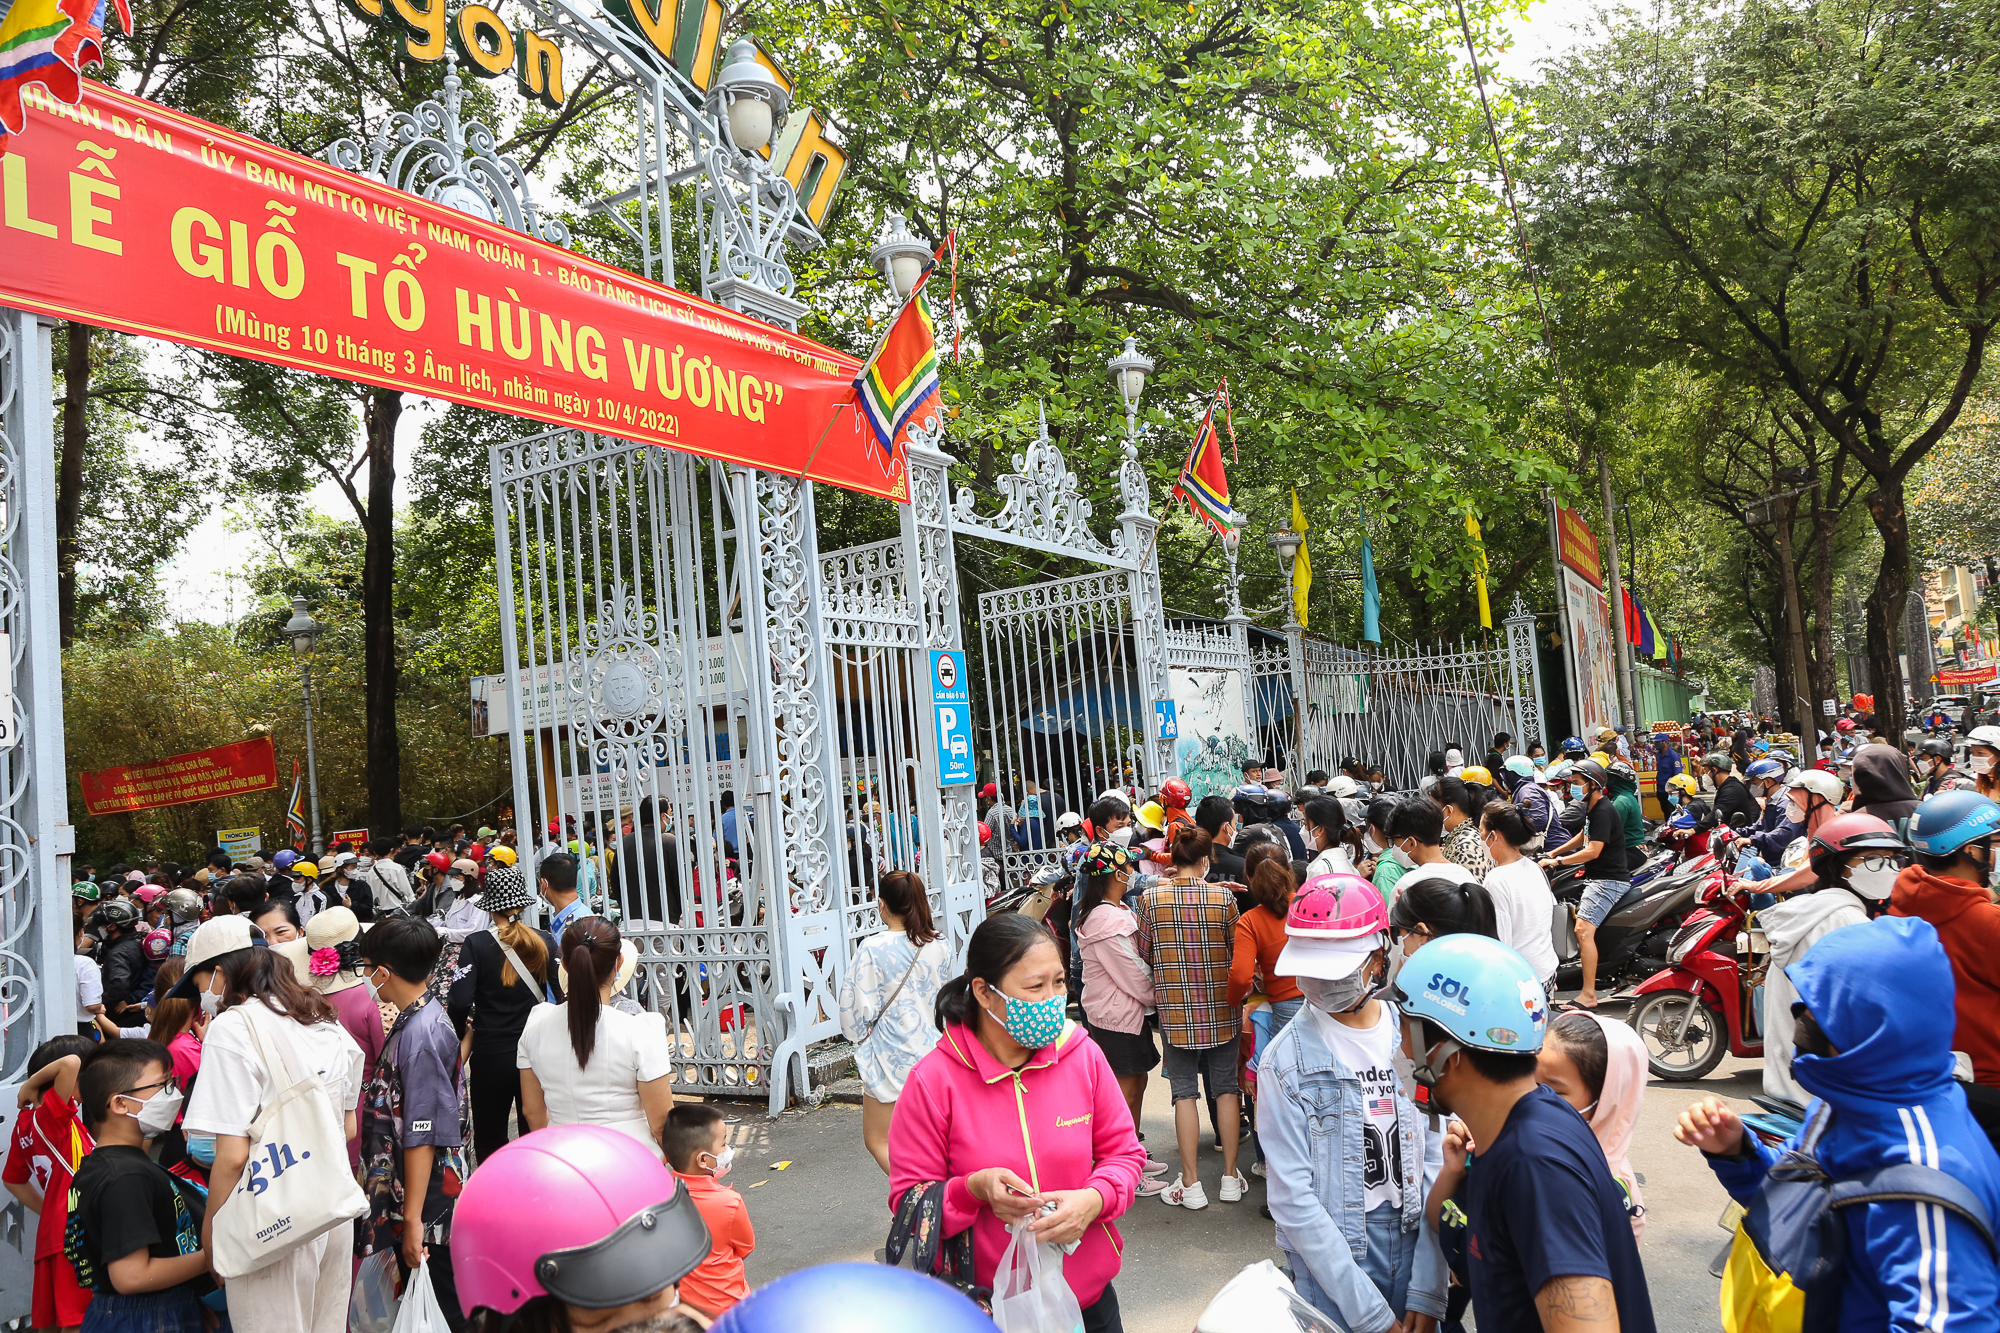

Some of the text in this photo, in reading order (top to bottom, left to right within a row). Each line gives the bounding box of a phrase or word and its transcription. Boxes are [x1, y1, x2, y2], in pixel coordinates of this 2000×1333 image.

[112, 116, 174, 155] DÂN
[201, 138, 236, 175] ỦY
[246, 161, 296, 196] BAN
[304, 182, 367, 218] MTTQ
[373, 202, 420, 237] VIỆT
[427, 222, 470, 252] NAM
[476, 242, 526, 272] QUẬN
[532, 259, 540, 276] 1
[558, 263, 592, 295] BẢO
[596, 276, 637, 308] TÀNG
[640, 290, 673, 319] LỊCH
[676, 304, 695, 326] SỬ
[697, 315, 744, 343] THÀNH
[745, 332, 772, 352] PHỐ
[774, 340, 790, 359] HỒ
[794, 349, 812, 367] CHÍ
[814, 356, 841, 378] MINH
[3, 140, 783, 425] LỄ GIỖ TỔ HÙNG VƯƠNG”
[215, 304, 680, 438] (Mùng 10 tháng 3 Âm lịch, nhằm ngày 10/4/2022)
[939, 708, 957, 750] P
[113, 783, 127, 795] ĐẢNG
[137, 780, 153, 792] CHÍNH
[153, 776, 172, 790] QUYỀN
[172, 774, 181, 786] VÀ
[180, 772, 198, 784] NHÂN
[197, 770, 212, 781] DÂN
[211, 766, 228, 779] QUẬN
[165, 760, 185, 774] THỐNG
[185, 760, 198, 770] CHA
[198, 756, 214, 768] ÔNG,
[950, 761, 965, 770] 50m
[94, 798, 109, 810] QUYẾT
[109, 798, 120, 808] TÂM
[120, 796, 131, 807] XÂY
[145, 792, 153, 803] VÀ
[153, 789, 164, 802] BẢO
[165, 789, 173, 801] VỆ
[174, 786, 182, 799] TỔ
[182, 784, 198, 798] QUỐC
[198, 782, 213, 794] NGÀY
[214, 780, 230, 792] CÀNG
[230, 777, 247, 789] VỮNG
[248, 774, 266, 787] MẠNH
[1968, 810, 1998, 827] UBER
[1423, 990, 1467, 1017] EXPLORERS
[1427, 973, 1470, 1006] SOL
[256, 1216, 291, 1240] monbr
